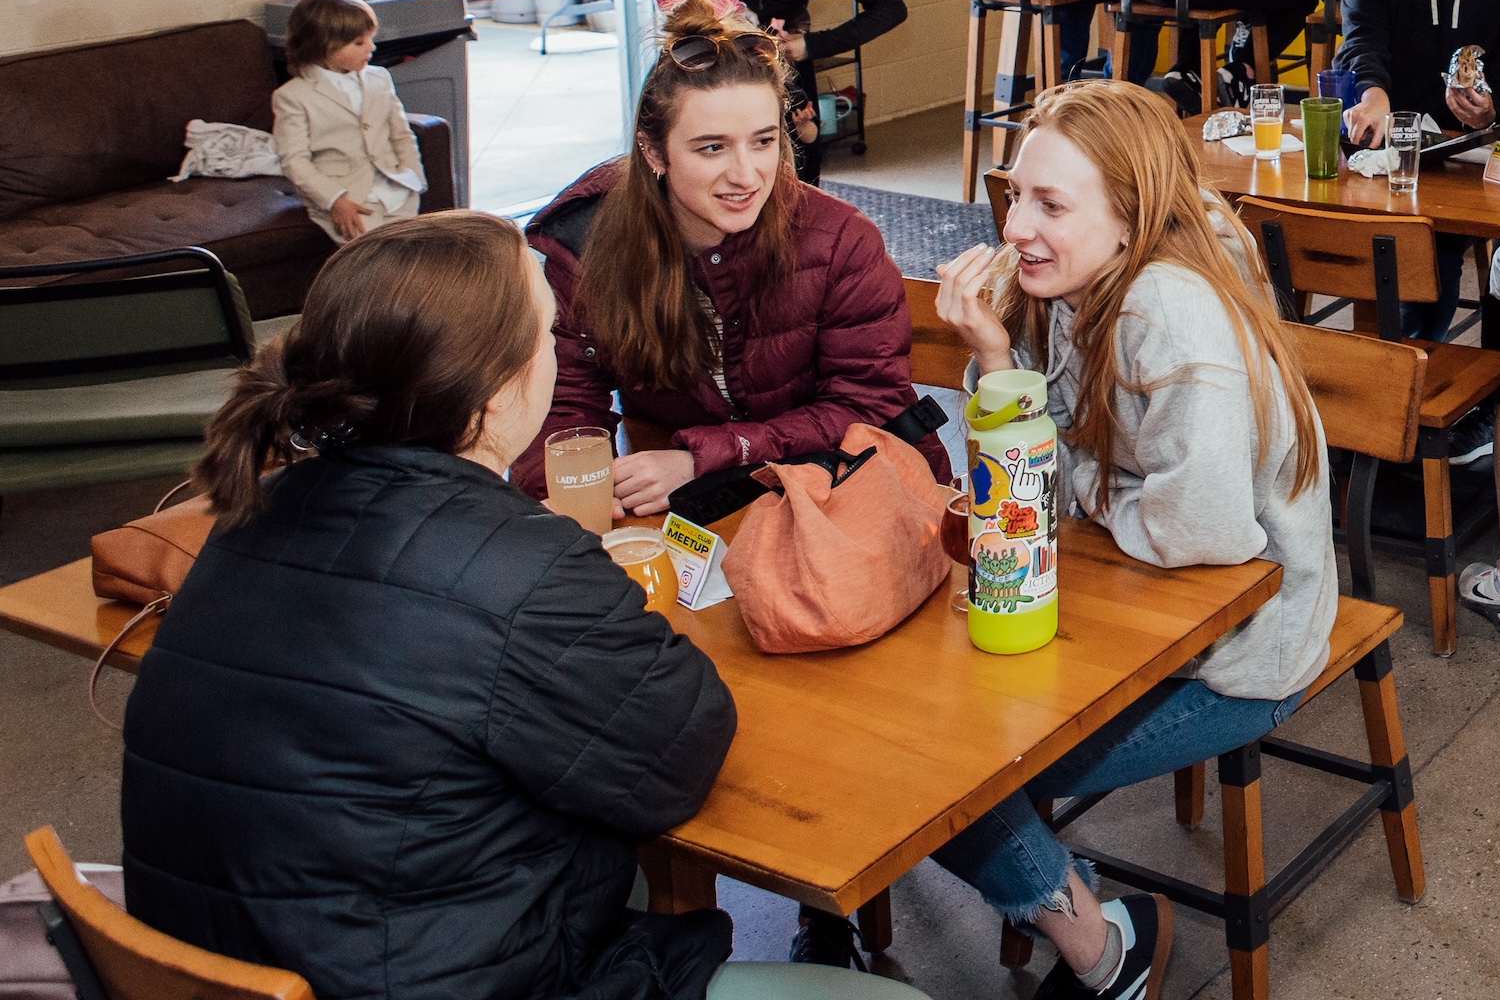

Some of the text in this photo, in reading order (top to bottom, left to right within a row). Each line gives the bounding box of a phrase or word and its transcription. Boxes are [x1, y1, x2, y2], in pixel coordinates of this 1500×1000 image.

[556, 466, 611, 484] LADY JUSTICE
[667, 527, 710, 554] MEETUP
[670, 520, 682, 530] THE
[697, 533, 712, 545] CLUB
